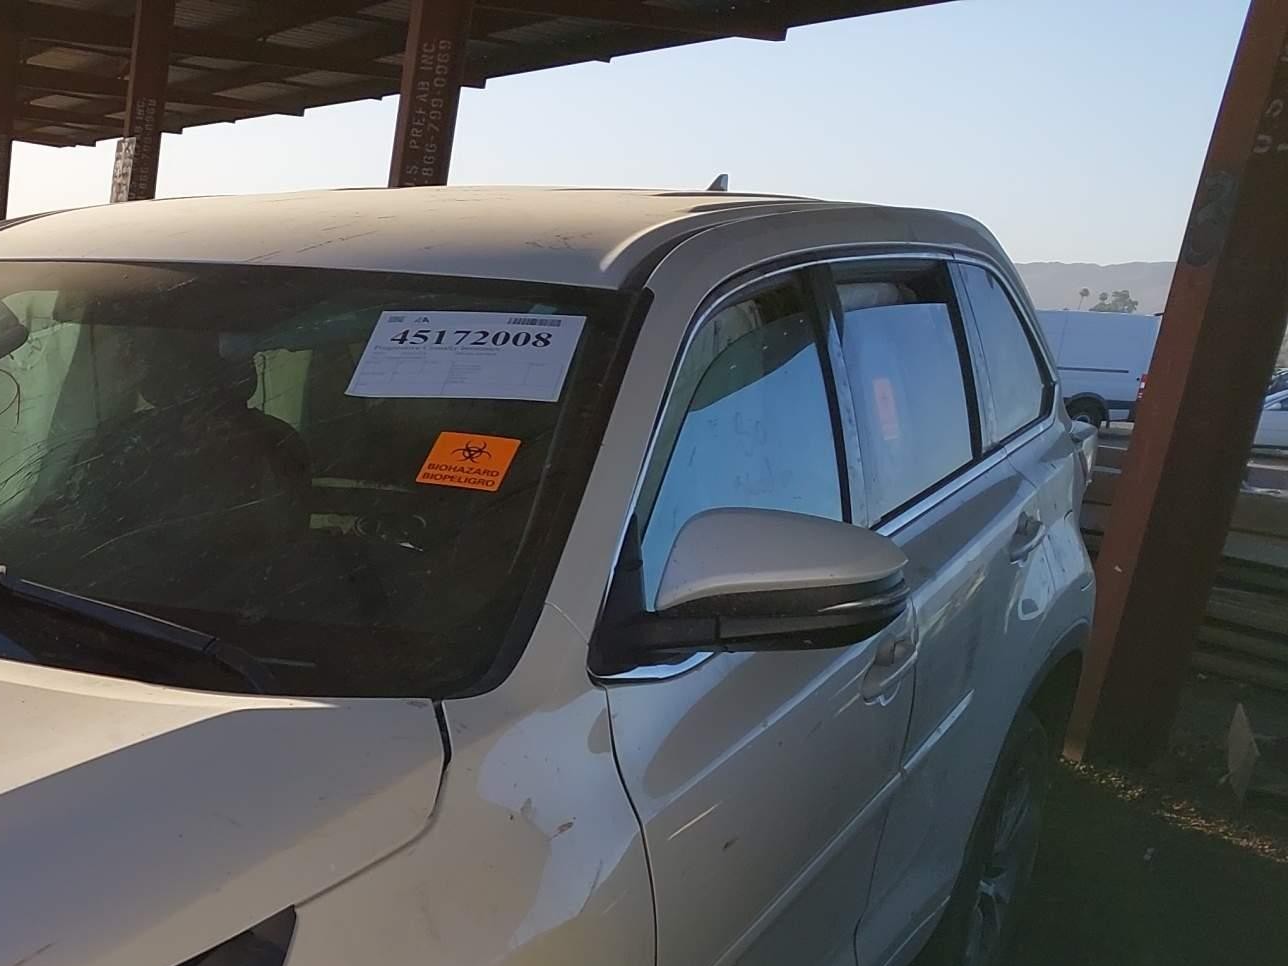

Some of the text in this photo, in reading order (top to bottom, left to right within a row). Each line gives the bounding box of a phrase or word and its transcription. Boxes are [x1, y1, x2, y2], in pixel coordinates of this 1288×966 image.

[409, 81, 430, 150] PREFAB
[390, 329, 553, 347] 45172008
[427, 463, 500, 477] BIOHAZARD
[422, 471, 495, 487] BIOPELIGRO
